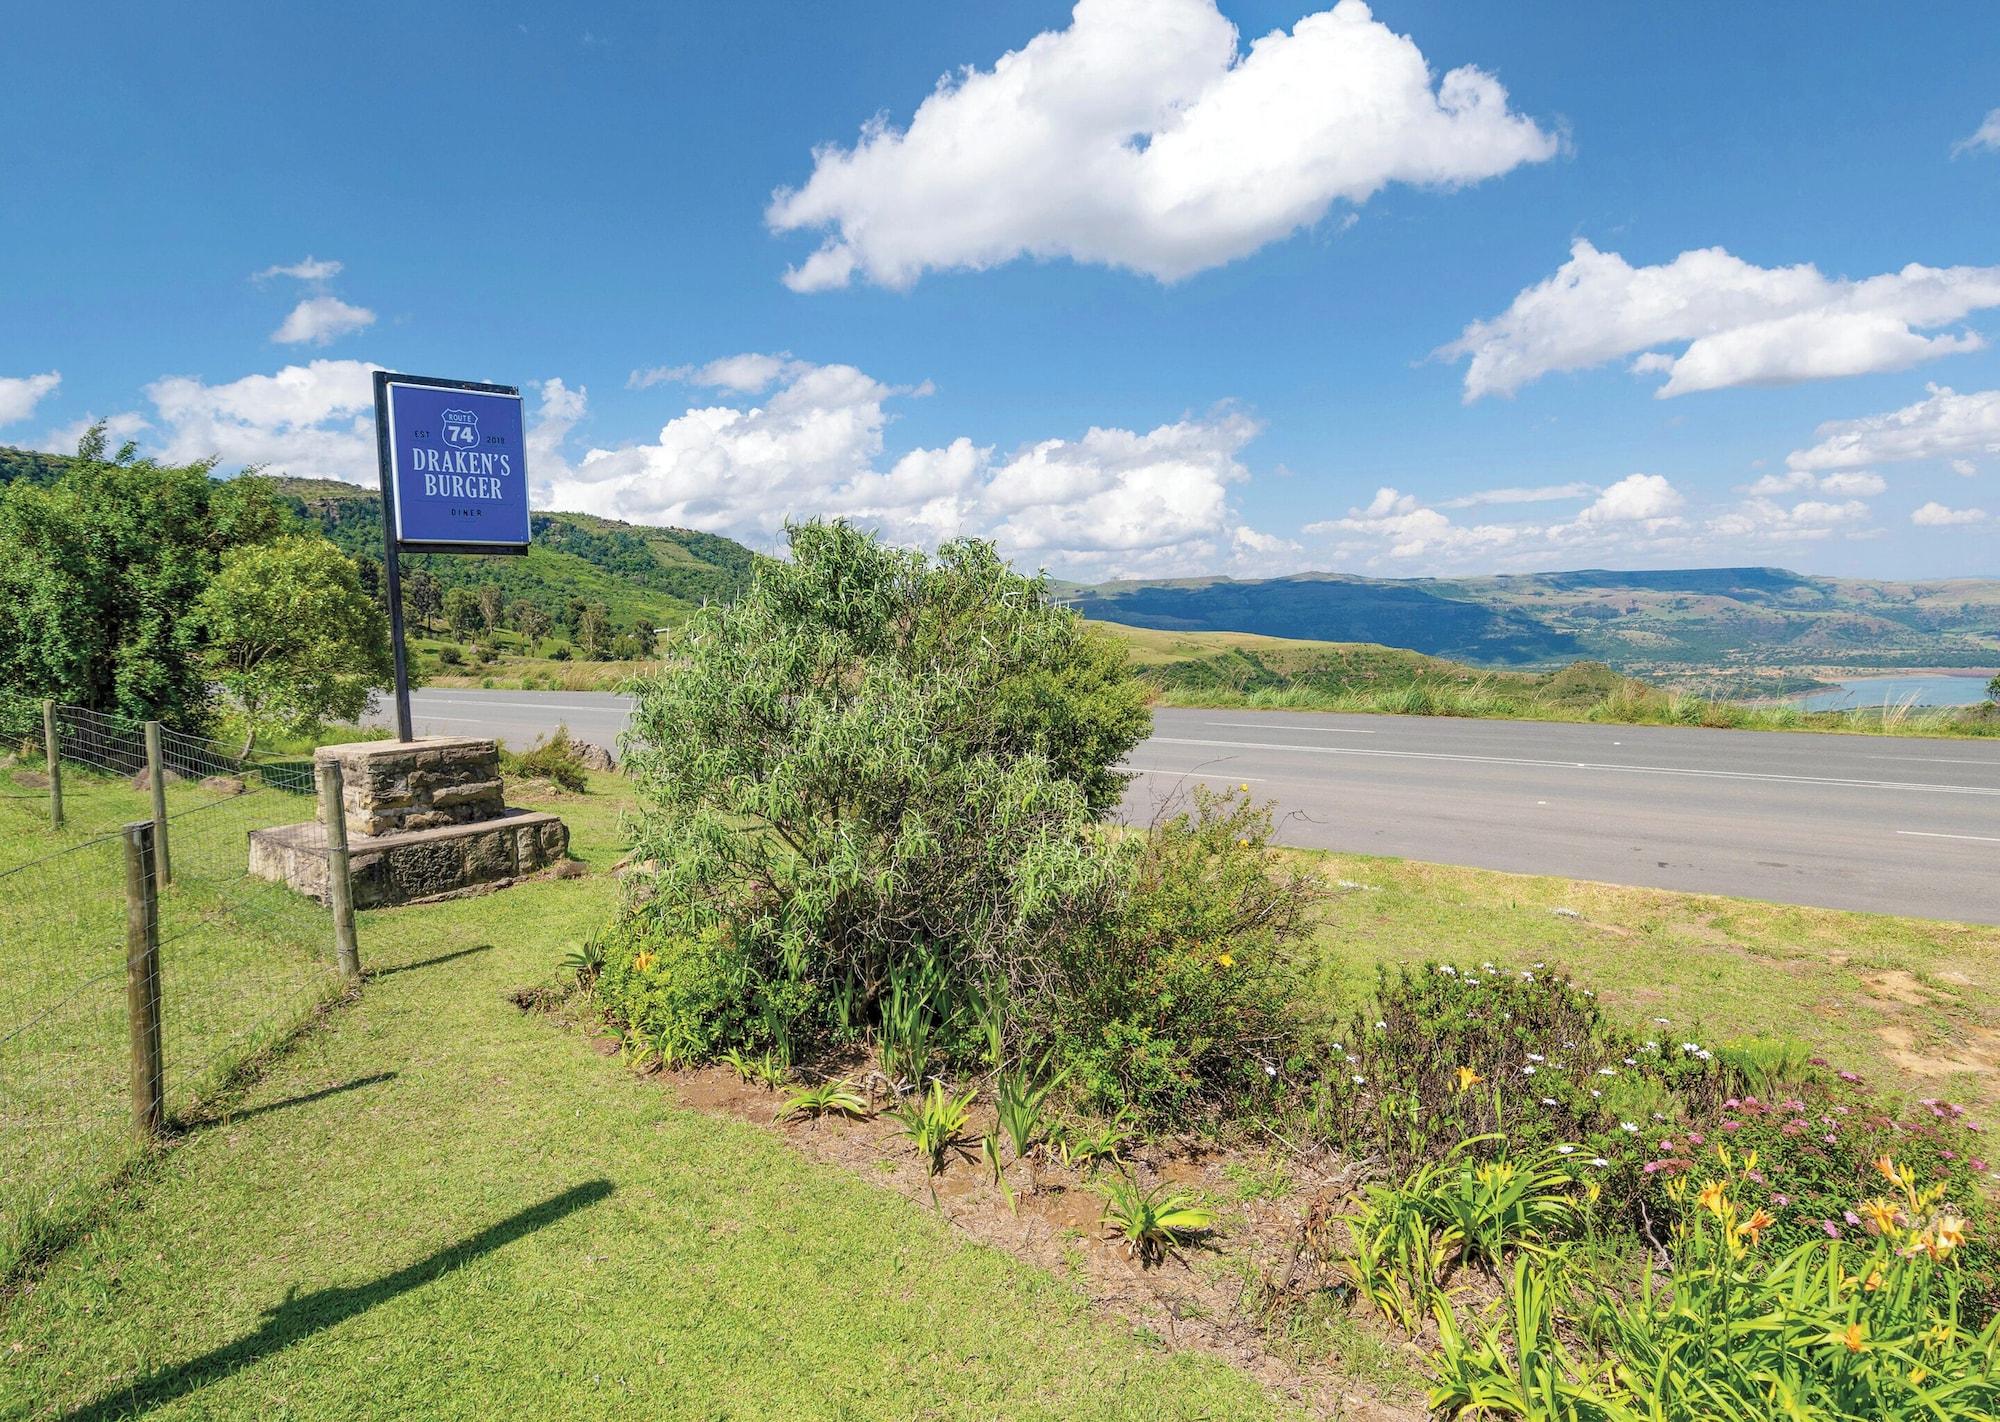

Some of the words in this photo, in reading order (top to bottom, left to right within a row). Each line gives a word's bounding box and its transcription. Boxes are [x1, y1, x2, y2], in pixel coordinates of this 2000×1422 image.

[448, 413, 472, 422] ROUTE
[448, 426, 473, 442] 74
[412, 448, 511, 476] DRAKEN'S
[424, 474, 503, 500] BURGER
[451, 509, 482, 517] DINER
